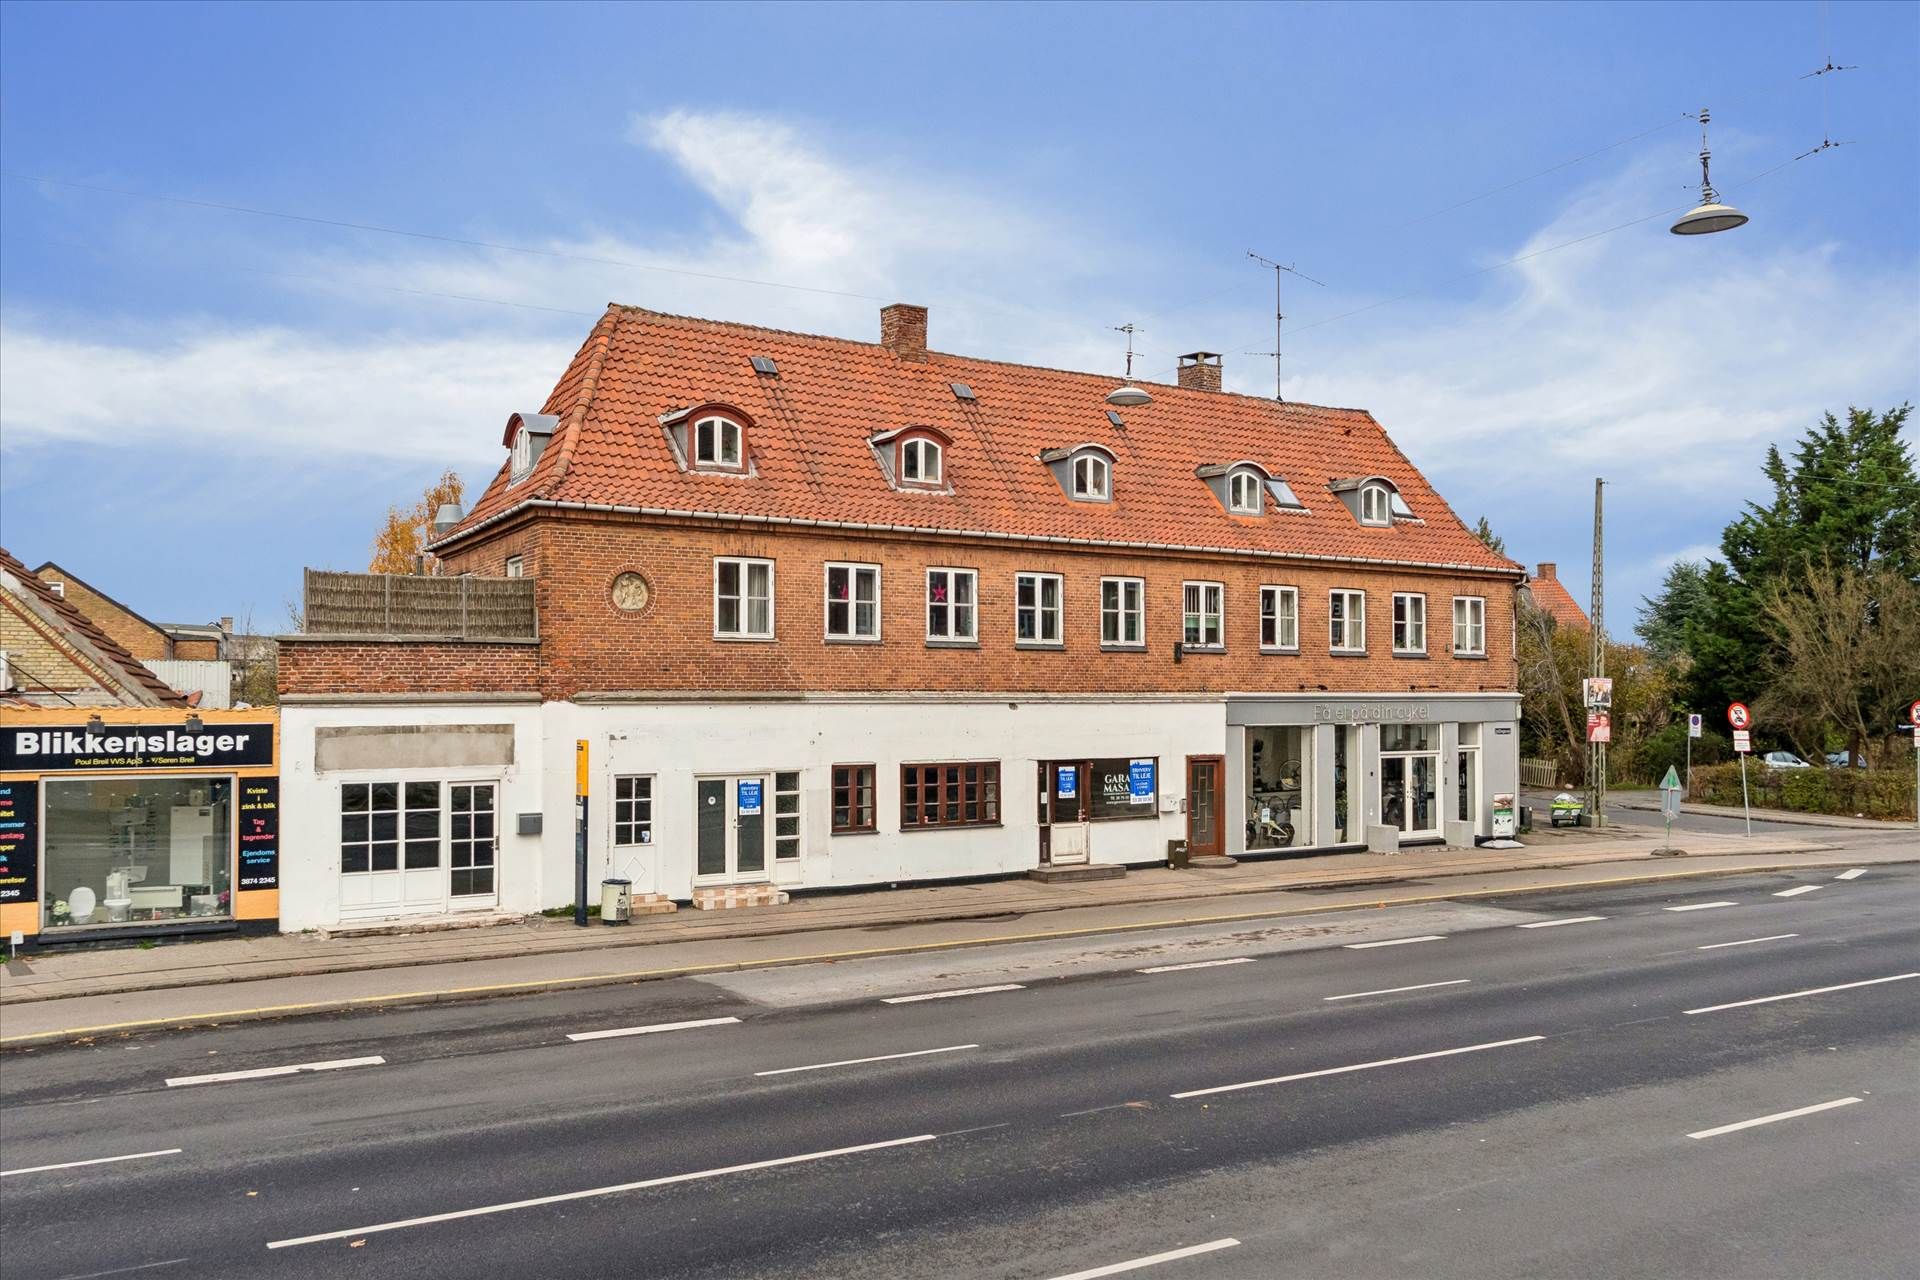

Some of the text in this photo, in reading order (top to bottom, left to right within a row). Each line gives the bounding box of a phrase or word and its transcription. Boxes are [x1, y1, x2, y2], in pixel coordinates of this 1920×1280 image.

[1314, 703, 1430, 722] Få el på din cykel
[15, 731, 250, 756] Blikkenslager
[109, 757, 126, 765] VVS
[1104, 773, 1130, 784] GARA
[1103, 783, 1130, 792] MASA
[242, 849, 275, 858] Ejendoms
